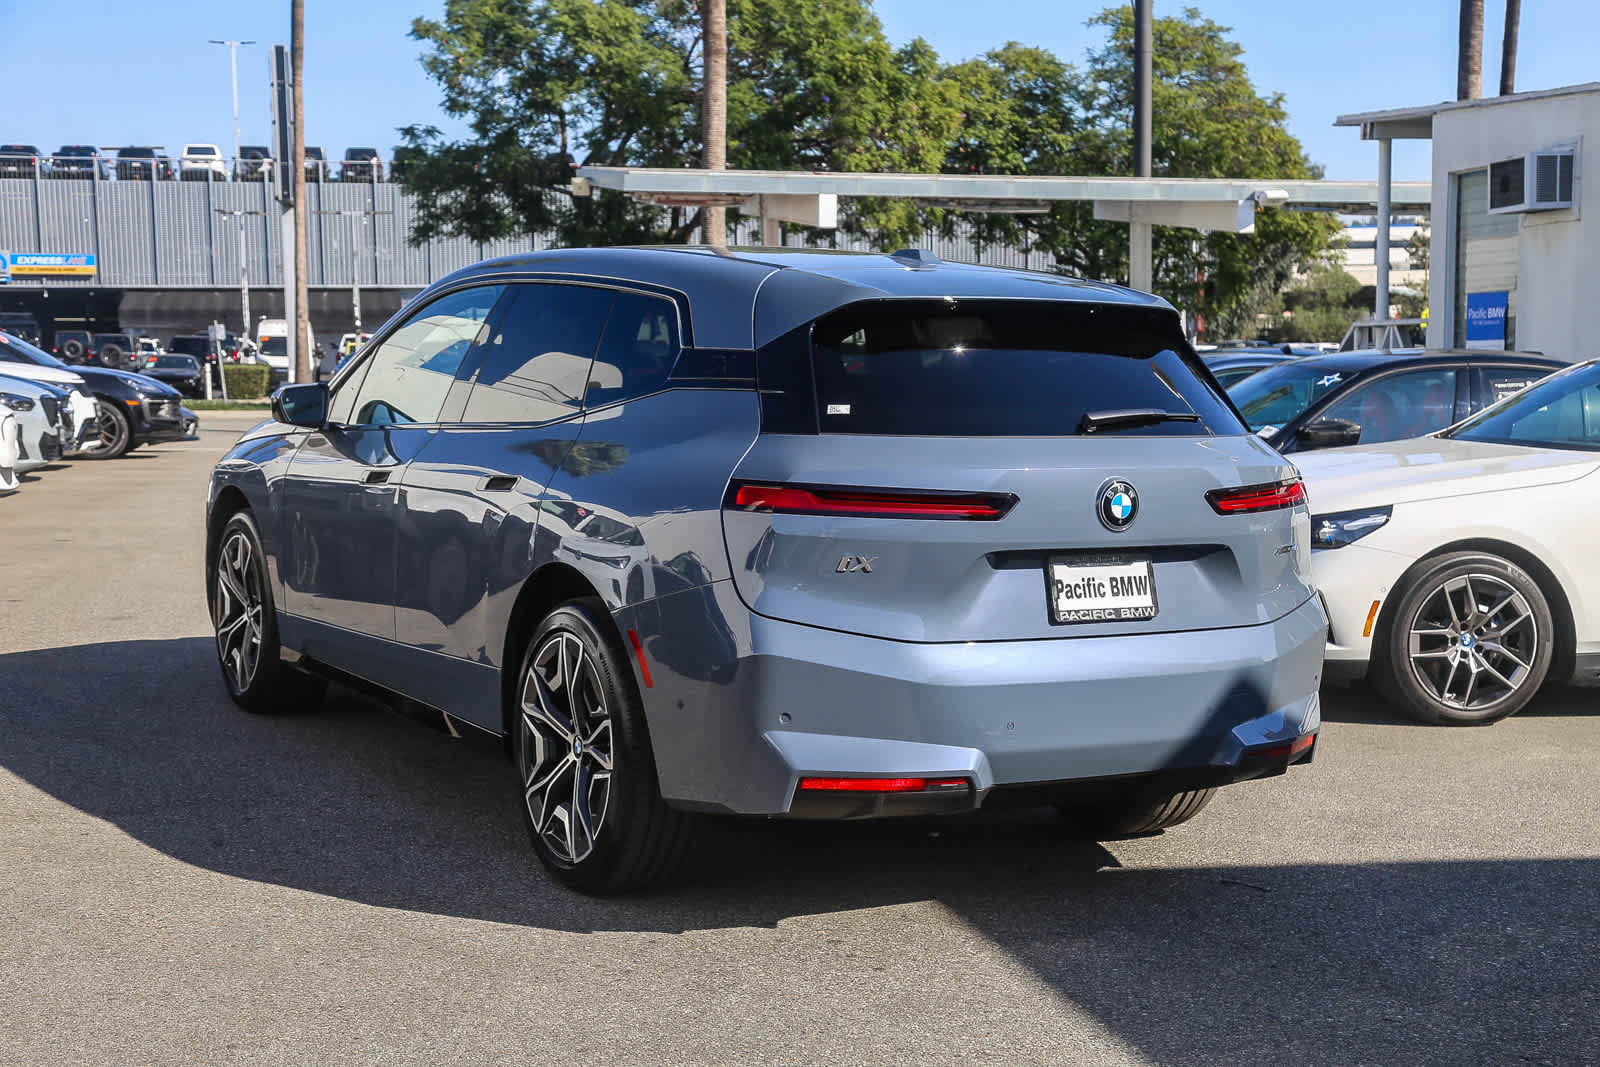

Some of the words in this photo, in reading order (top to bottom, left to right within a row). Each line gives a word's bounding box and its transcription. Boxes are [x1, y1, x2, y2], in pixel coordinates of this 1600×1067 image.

[1487, 306, 1506, 319] BMW
[1055, 577, 1106, 600] Pacific
[1109, 575, 1148, 597] BMW
[1059, 608, 1116, 622] PACIFIC
[1120, 606, 1156, 619] BMW
